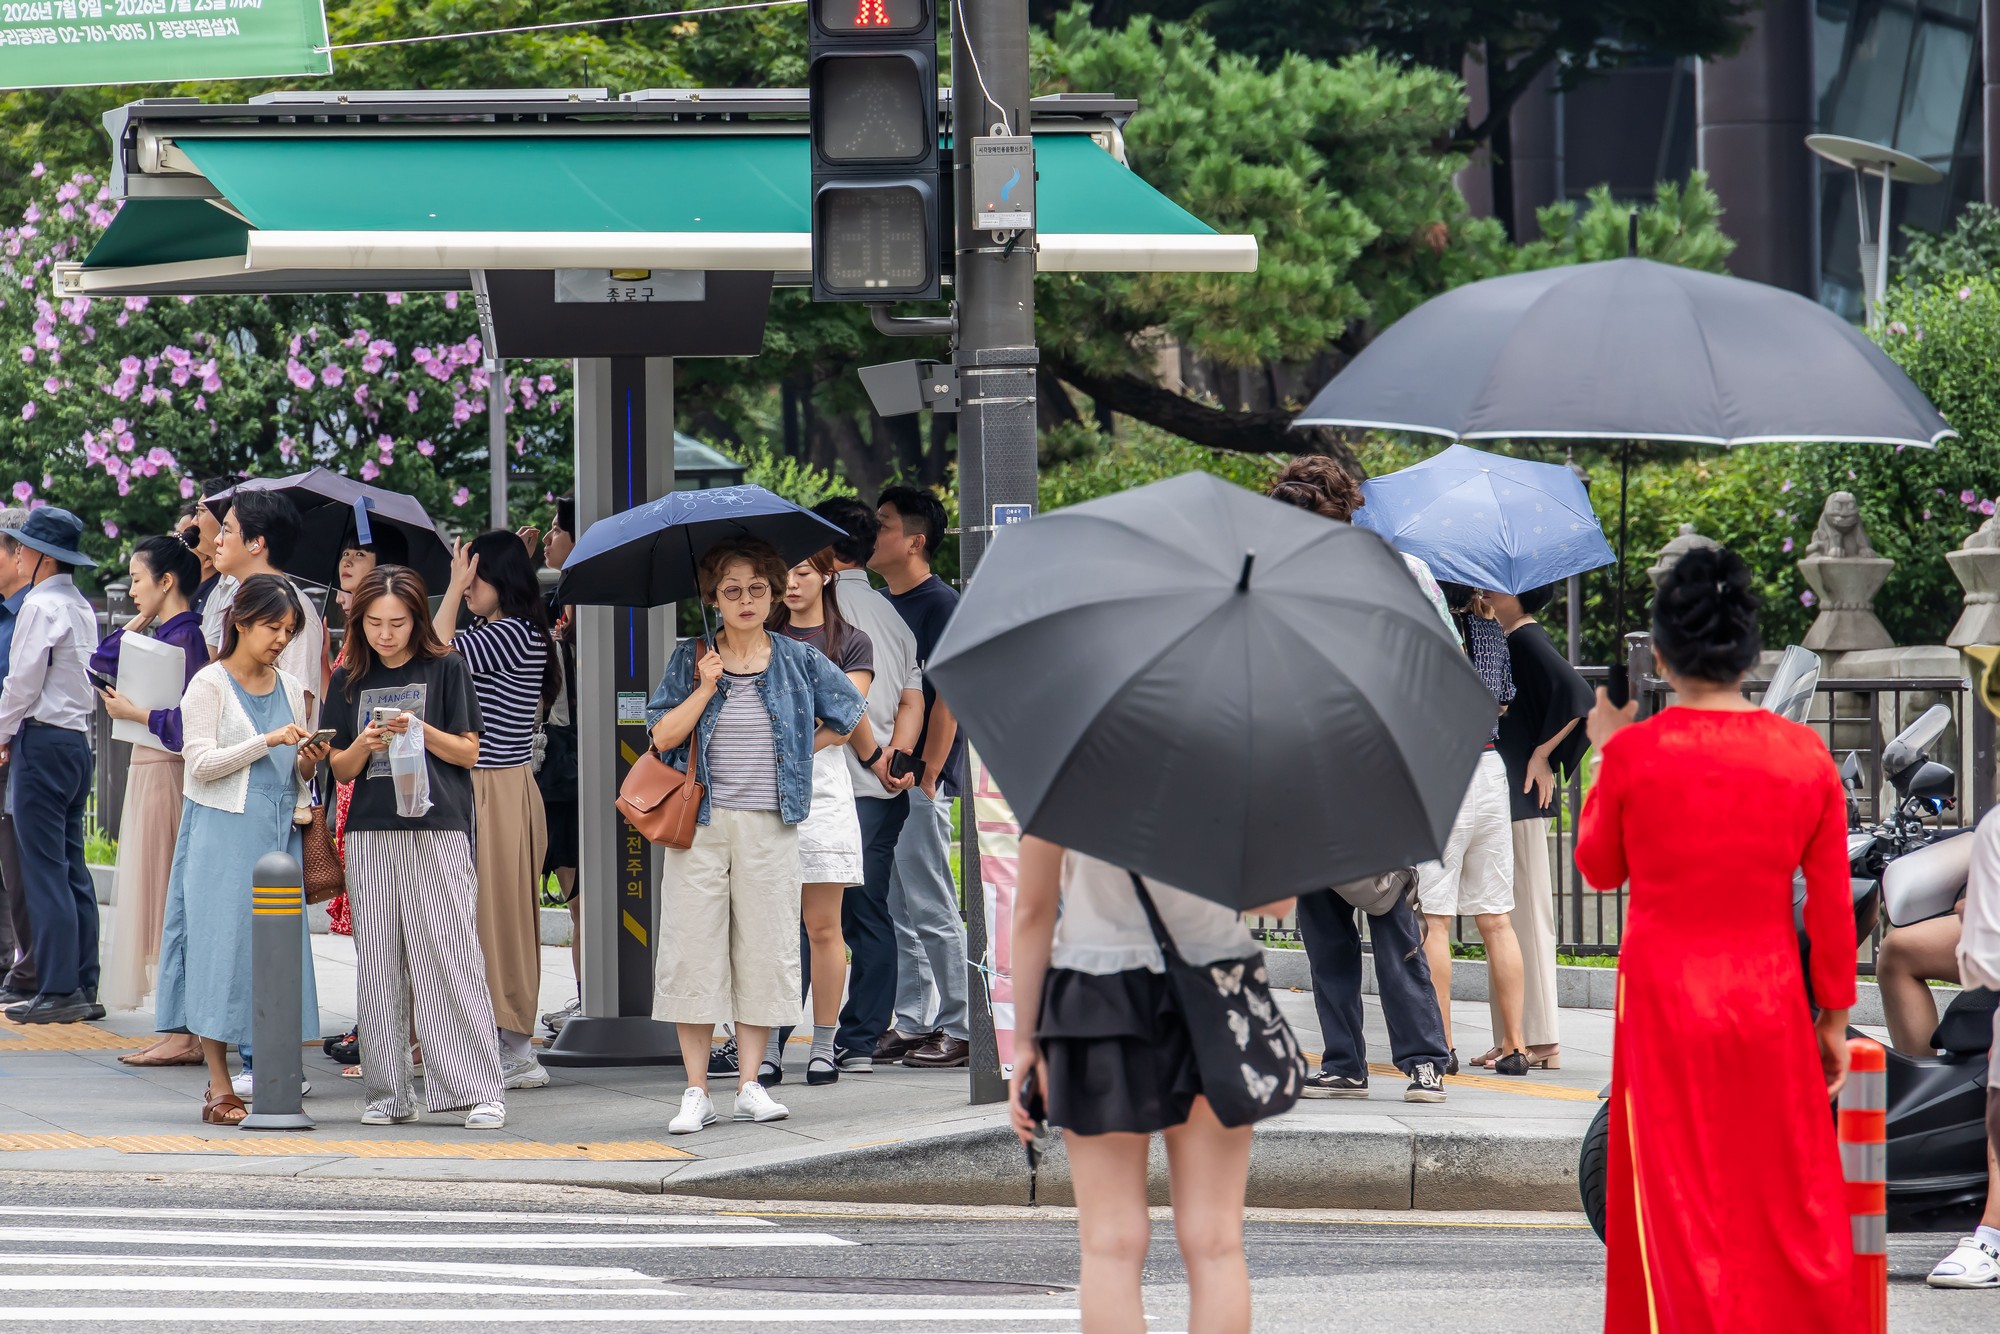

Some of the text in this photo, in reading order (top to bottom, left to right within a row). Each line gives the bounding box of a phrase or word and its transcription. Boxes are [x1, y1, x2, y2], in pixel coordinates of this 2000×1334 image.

[2, 2, 53, 22] 2026년
[54, 0, 77, 19] 7월
[78, 0, 102, 18] 9일
[115, 0, 166, 16] 2026년
[58, 23, 147, 43] 02-761-0815
[156, 17, 240, 38] 정당직접설치
[607, 288, 655, 301] 종로구
[378, 690, 420, 704] MANGER
